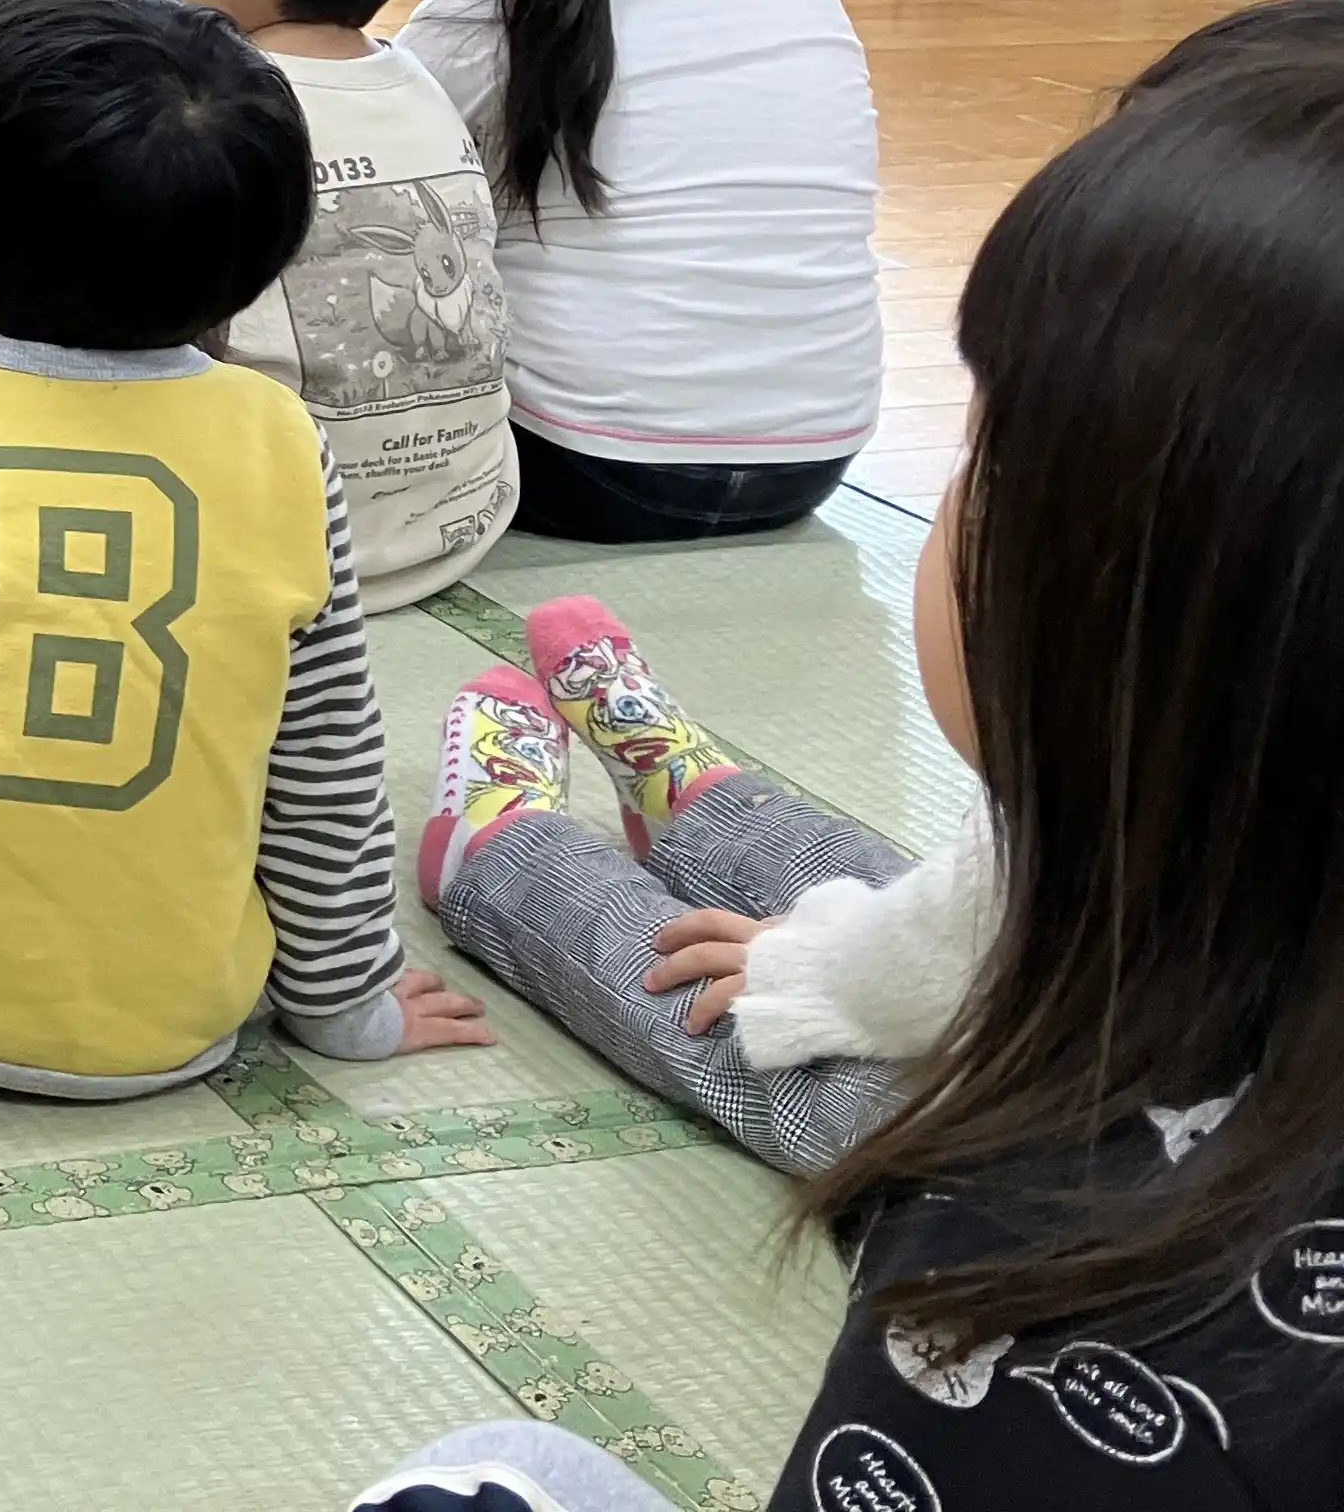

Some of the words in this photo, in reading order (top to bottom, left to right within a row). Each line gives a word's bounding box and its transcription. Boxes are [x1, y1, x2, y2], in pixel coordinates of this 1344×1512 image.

[382, 434, 410, 452] Call
[413, 432, 434, 448] for
[437, 421, 479, 444] Family
